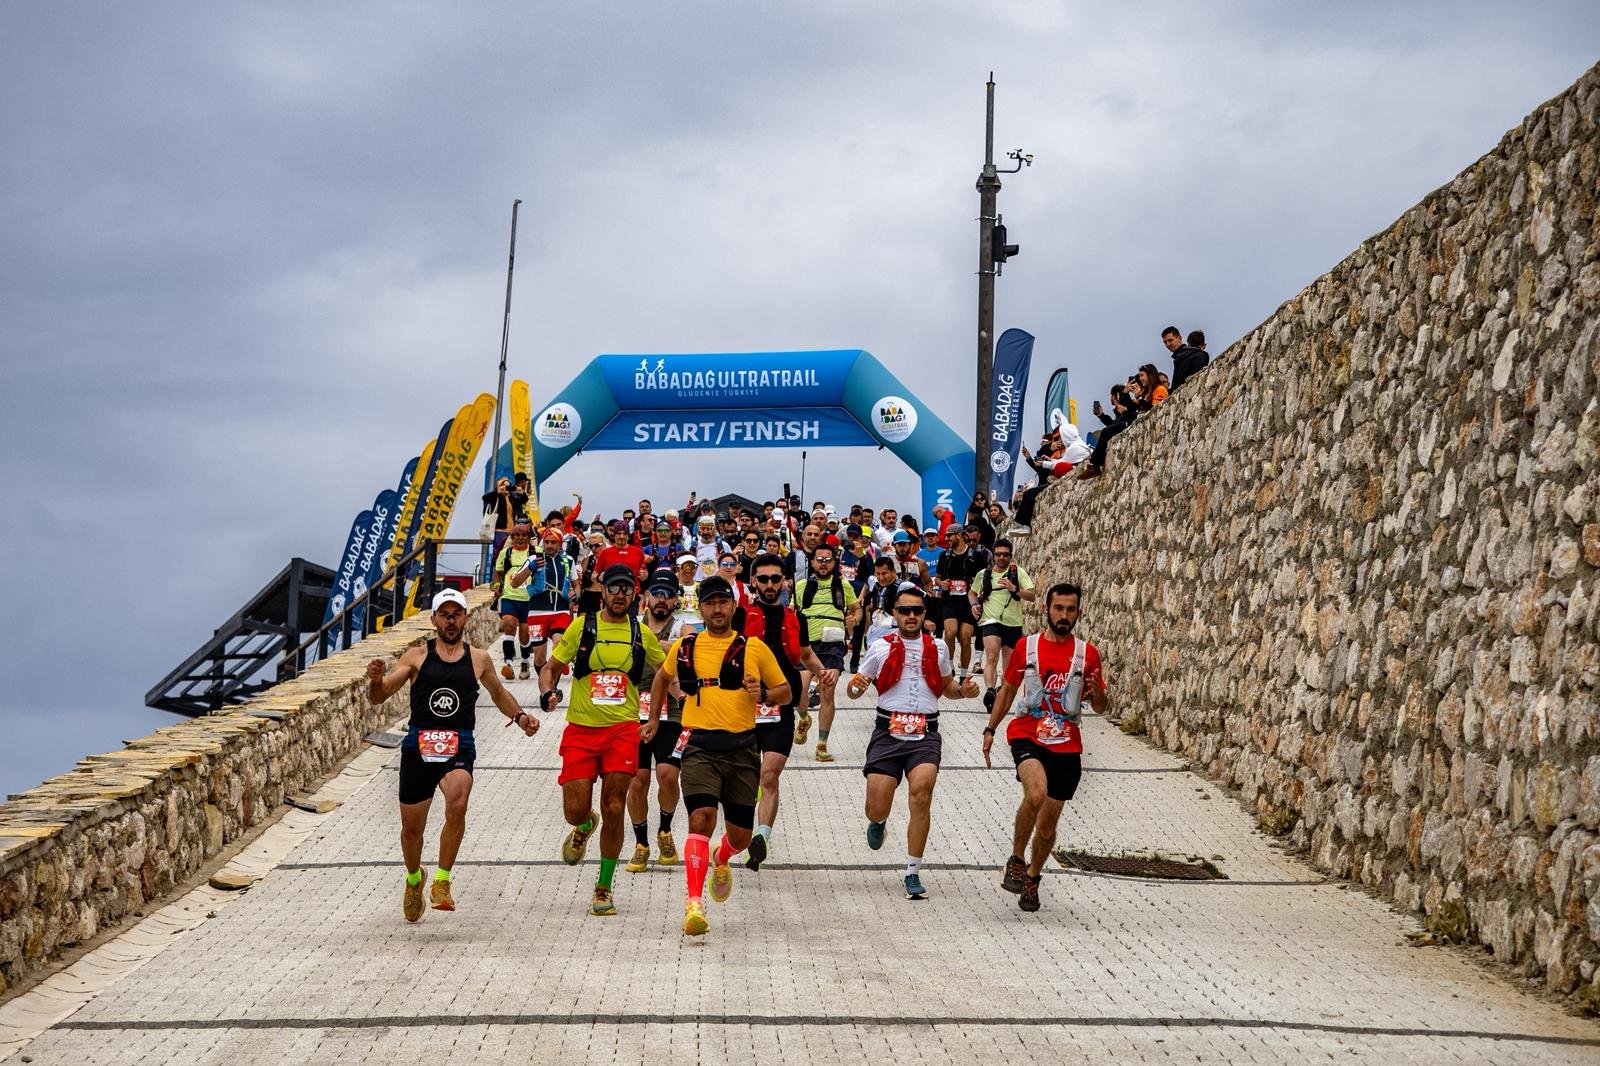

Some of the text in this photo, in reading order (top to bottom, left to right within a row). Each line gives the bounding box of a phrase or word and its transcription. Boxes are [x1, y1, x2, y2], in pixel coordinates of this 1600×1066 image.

[718, 369, 819, 388] ULTRATRAIL
[633, 420, 820, 445] START/FINISH
[359, 504, 389, 573] BABADAĞ
[595, 674, 623, 684] 2641
[895, 714, 922, 723] 2696
[423, 731, 454, 741] 2687
